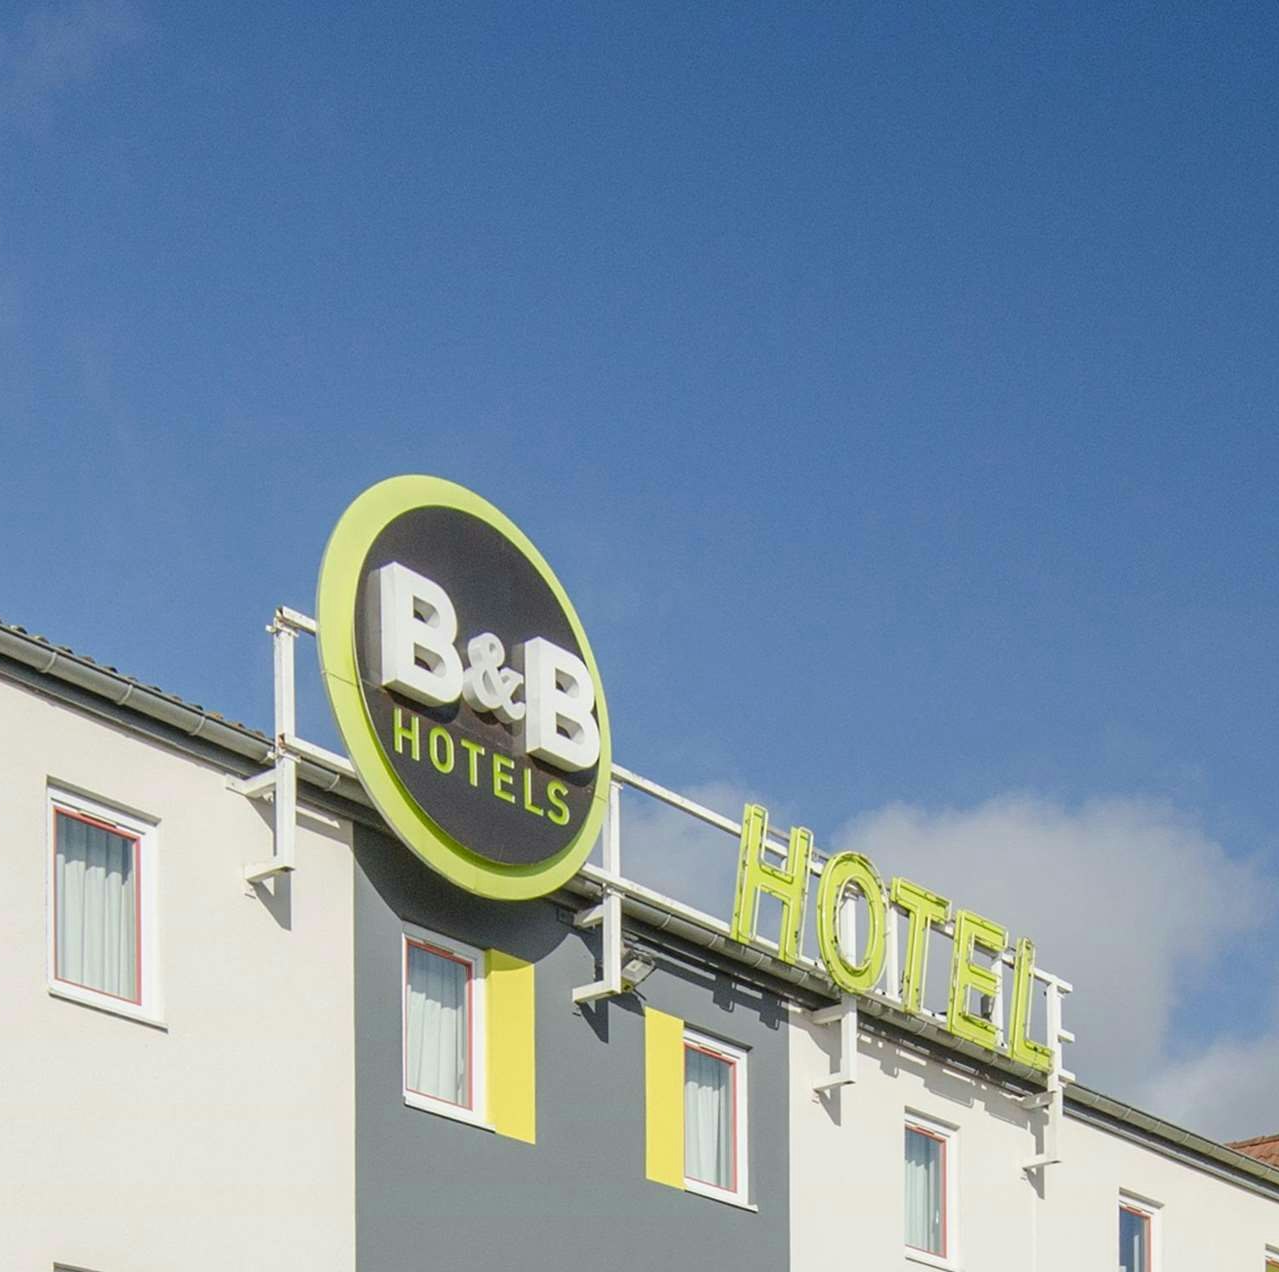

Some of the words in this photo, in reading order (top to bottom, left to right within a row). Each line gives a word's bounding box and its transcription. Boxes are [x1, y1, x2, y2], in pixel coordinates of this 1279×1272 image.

[379, 561, 601, 773] B&B
[392, 708, 572, 827] HOTELS
[730, 803, 1054, 1076] HOTEL
